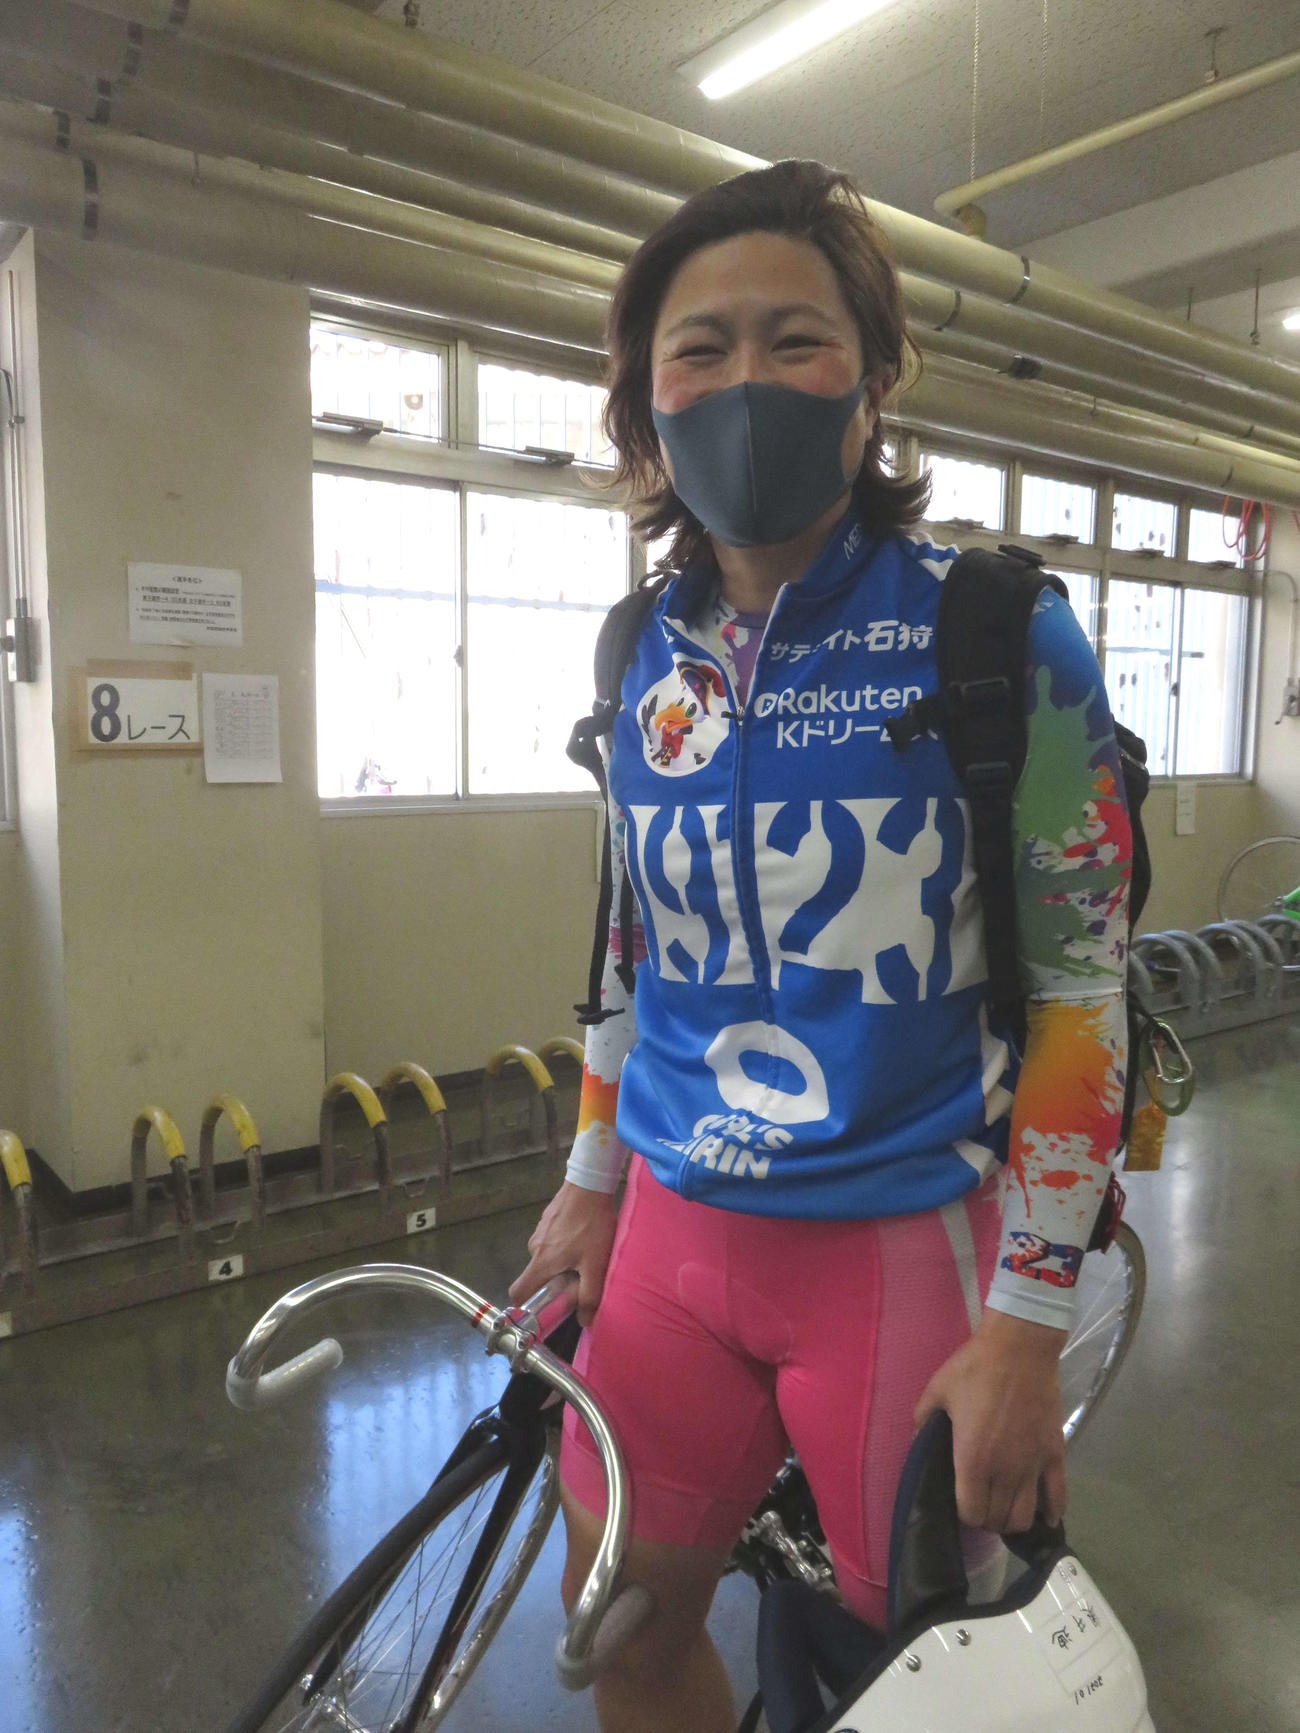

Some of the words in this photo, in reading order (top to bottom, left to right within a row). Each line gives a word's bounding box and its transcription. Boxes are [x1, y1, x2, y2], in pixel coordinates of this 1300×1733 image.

[770, 620, 933, 663] サテイト石狩
[90, 683, 191, 743] 8レース
[777, 684, 923, 716] Rakuten
[776, 718, 939, 749] Kドリー
[416, 1212, 427, 1228] 5
[219, 1260, 233, 1275] 4
